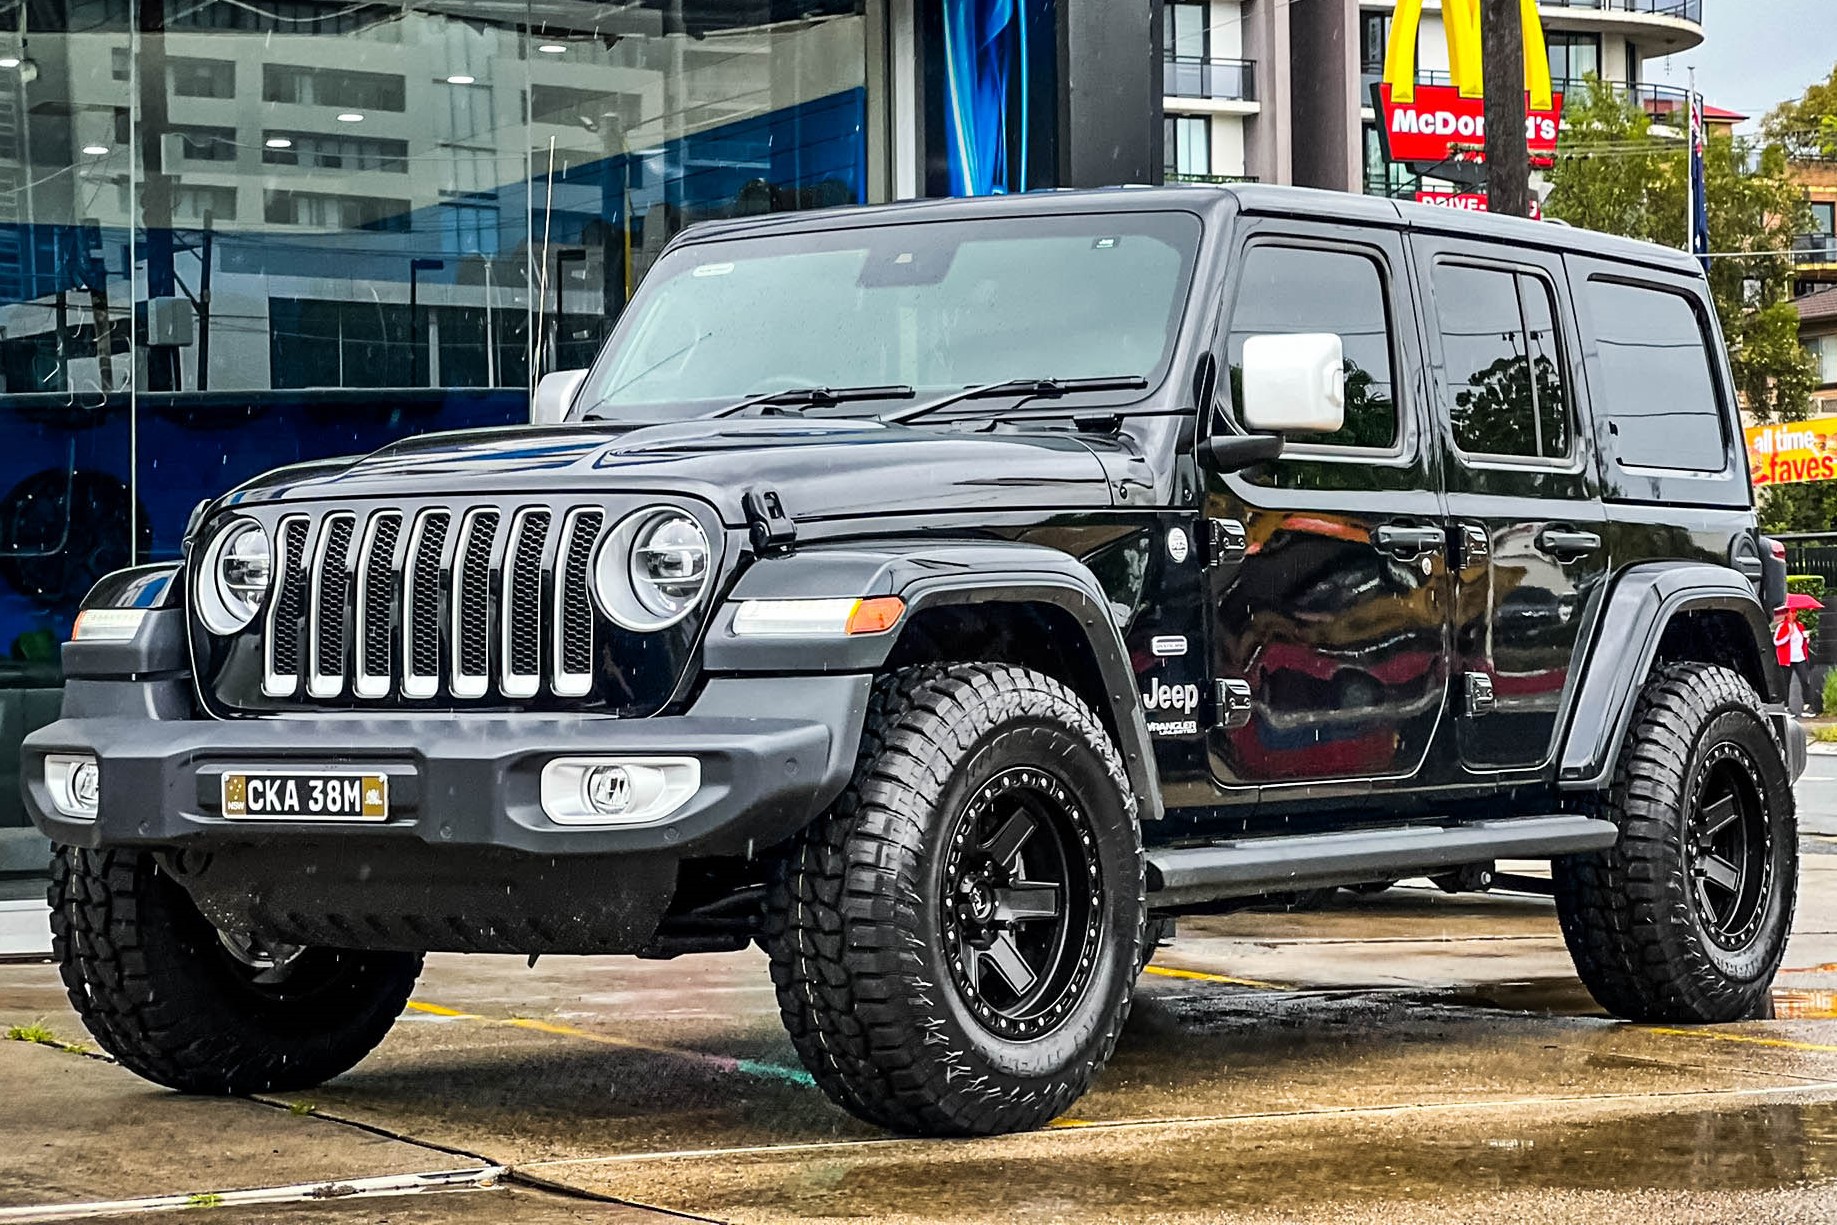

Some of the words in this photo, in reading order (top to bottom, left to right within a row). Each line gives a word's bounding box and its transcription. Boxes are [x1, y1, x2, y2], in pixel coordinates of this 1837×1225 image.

[1754, 429, 1773, 454] all
[1775, 426, 1814, 452] time
[1769, 452, 1834, 483] faves
[1143, 677, 1198, 714] Jeep
[227, 801, 245, 811] NSW
[247, 779, 300, 812] CKA
[308, 779, 361, 812] 38M
